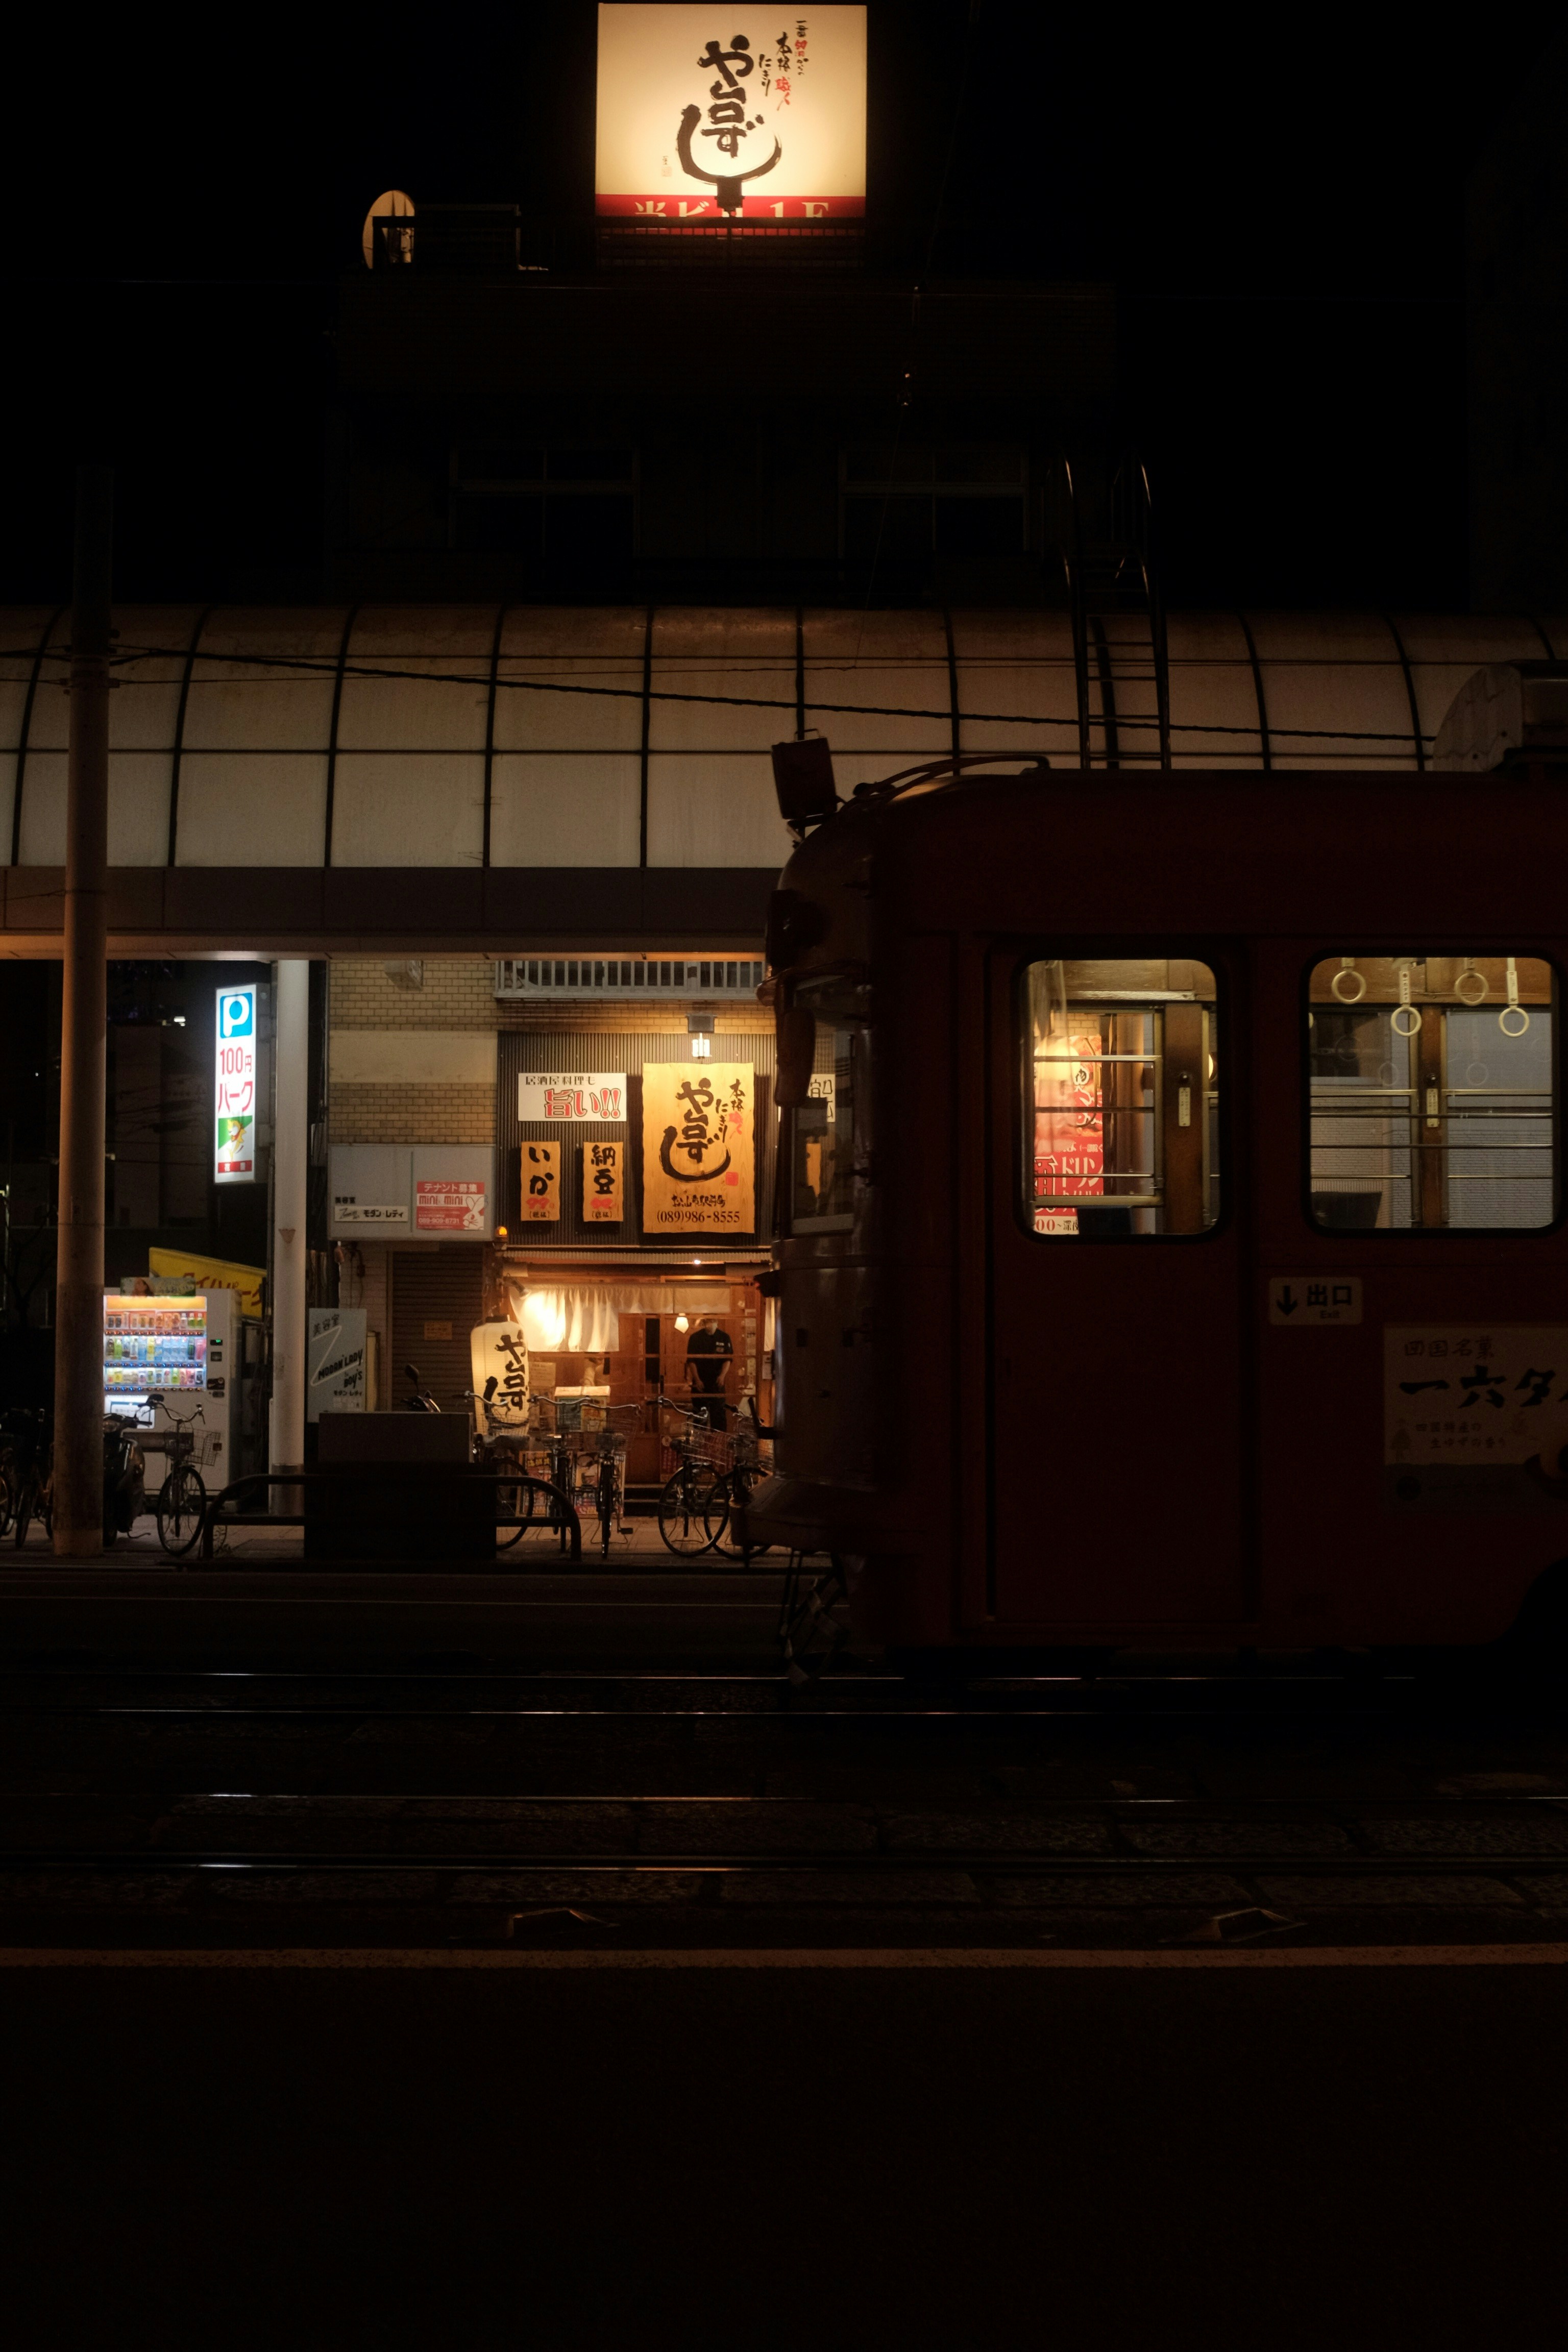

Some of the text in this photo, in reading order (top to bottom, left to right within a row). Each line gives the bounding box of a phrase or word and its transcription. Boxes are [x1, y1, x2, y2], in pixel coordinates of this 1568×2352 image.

[223, 995, 250, 1037] P
[219, 1046, 252, 1075] 100円
[525, 1075, 596, 1086] 居酒屋料理も
[528, 1146, 554, 1196] いか
[591, 1144, 616, 1194] 納豆
[424, 1183, 477, 1193] テナント募集
[1307, 1284, 1352, 1307] 出口
[1319, 1310, 1340, 1319] Exit
[1404, 1335, 1495, 1360] 四国名菓
[1399, 1364, 1568, 1409] 一六タ
